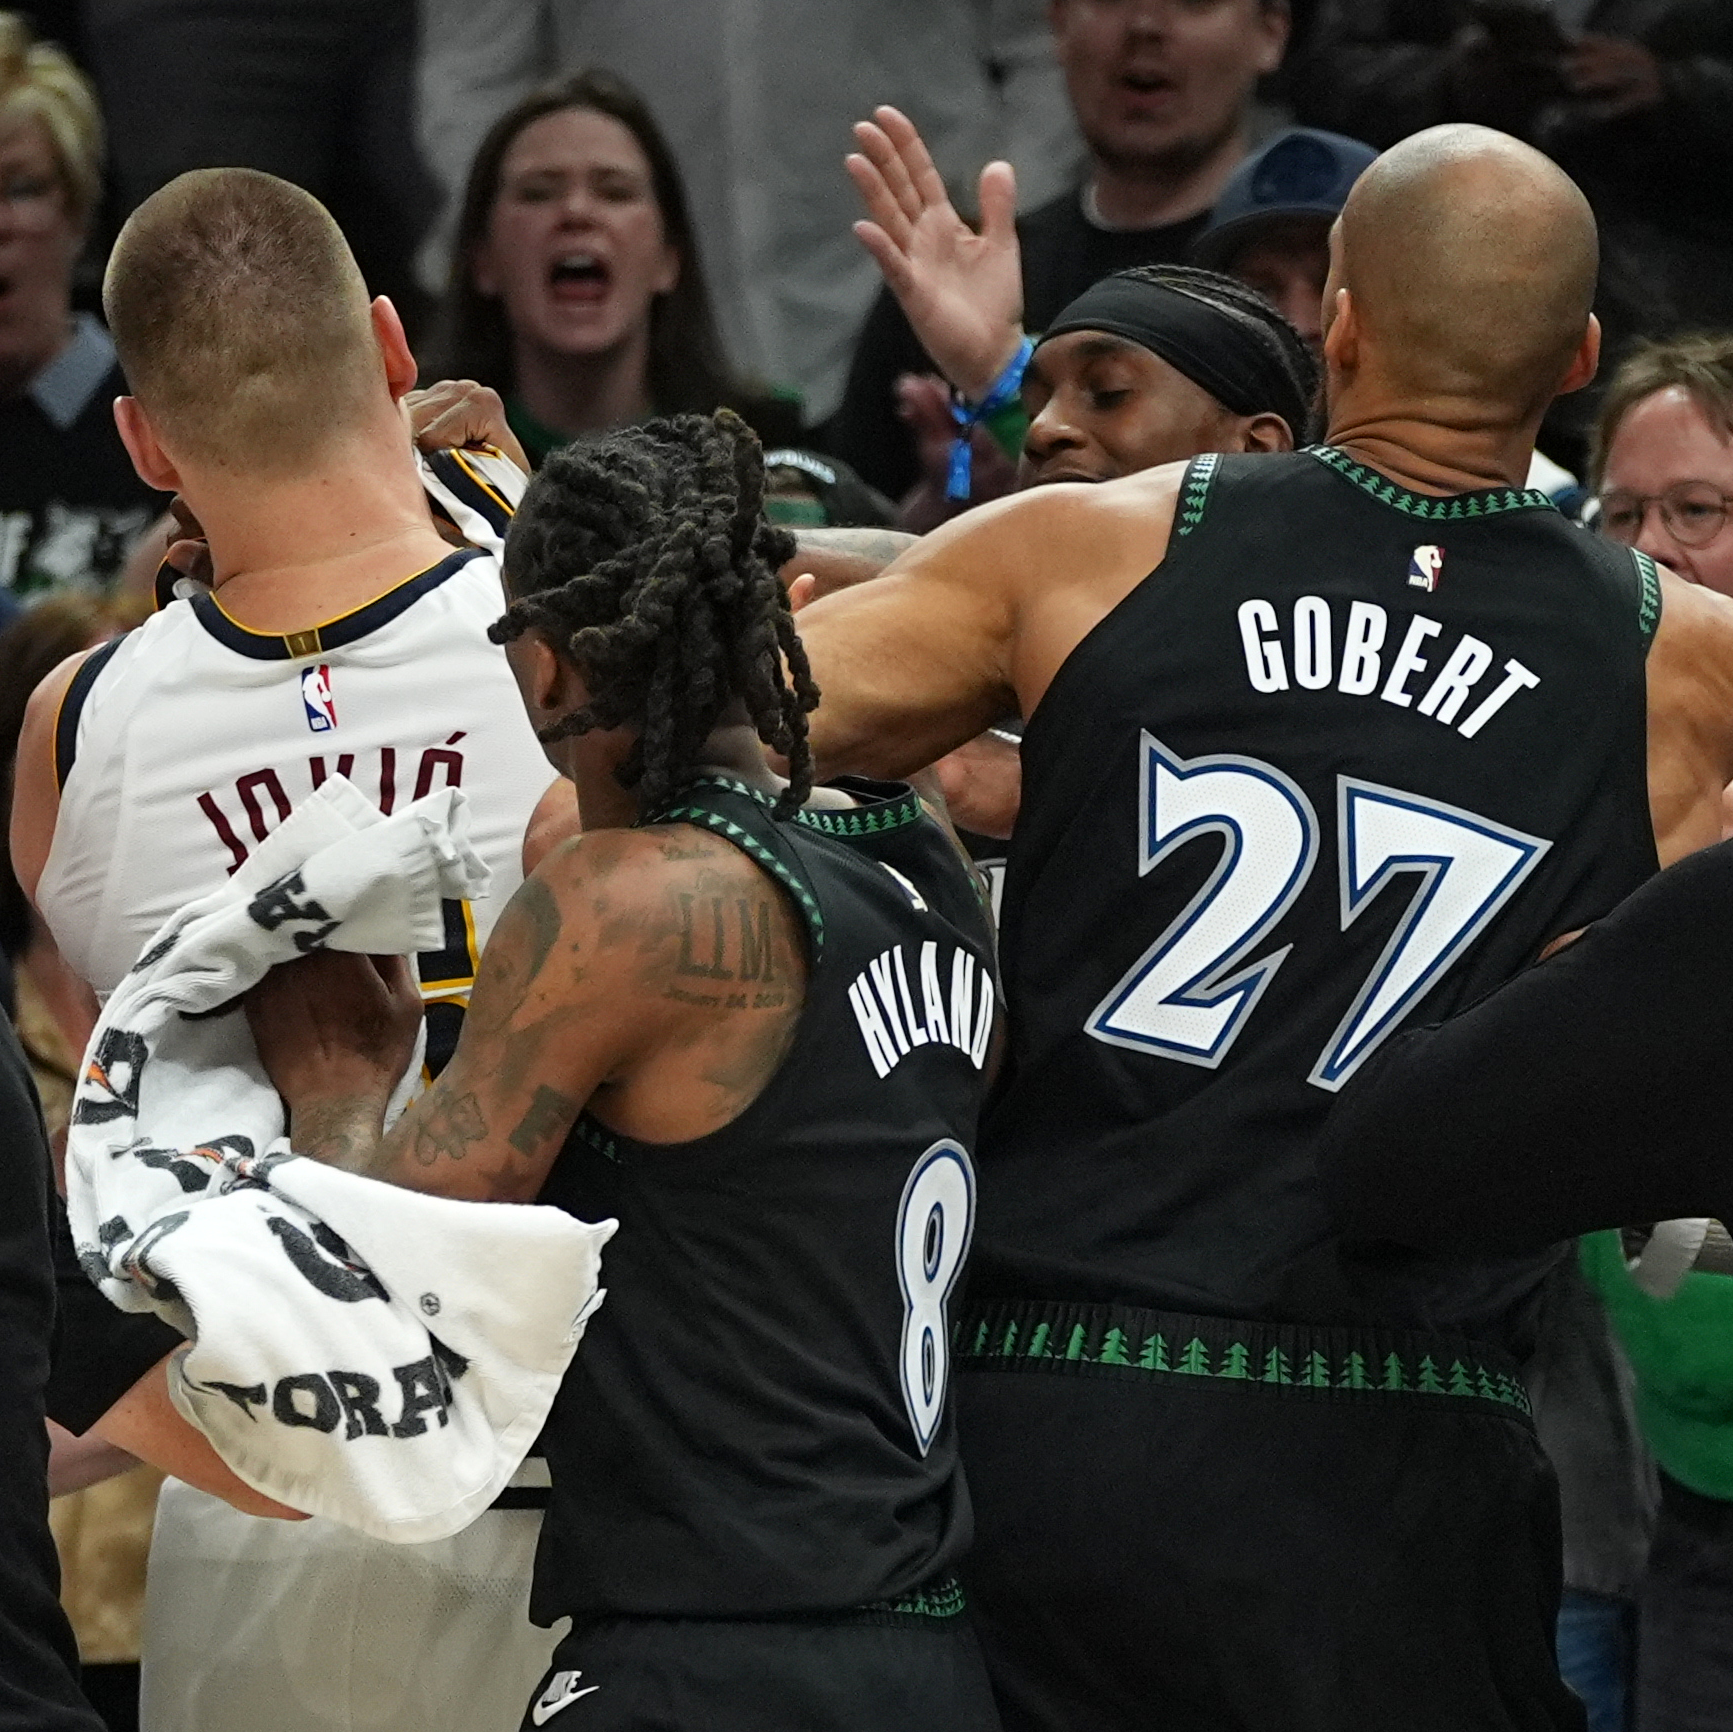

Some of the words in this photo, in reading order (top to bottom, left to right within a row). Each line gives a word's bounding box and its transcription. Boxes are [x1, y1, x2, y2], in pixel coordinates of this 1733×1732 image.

[1237, 595, 1540, 739] GOBERT
[848, 941, 994, 1079] HYLAND
[1084, 729, 1553, 1091] 27
[895, 1137, 977, 1457] 8
